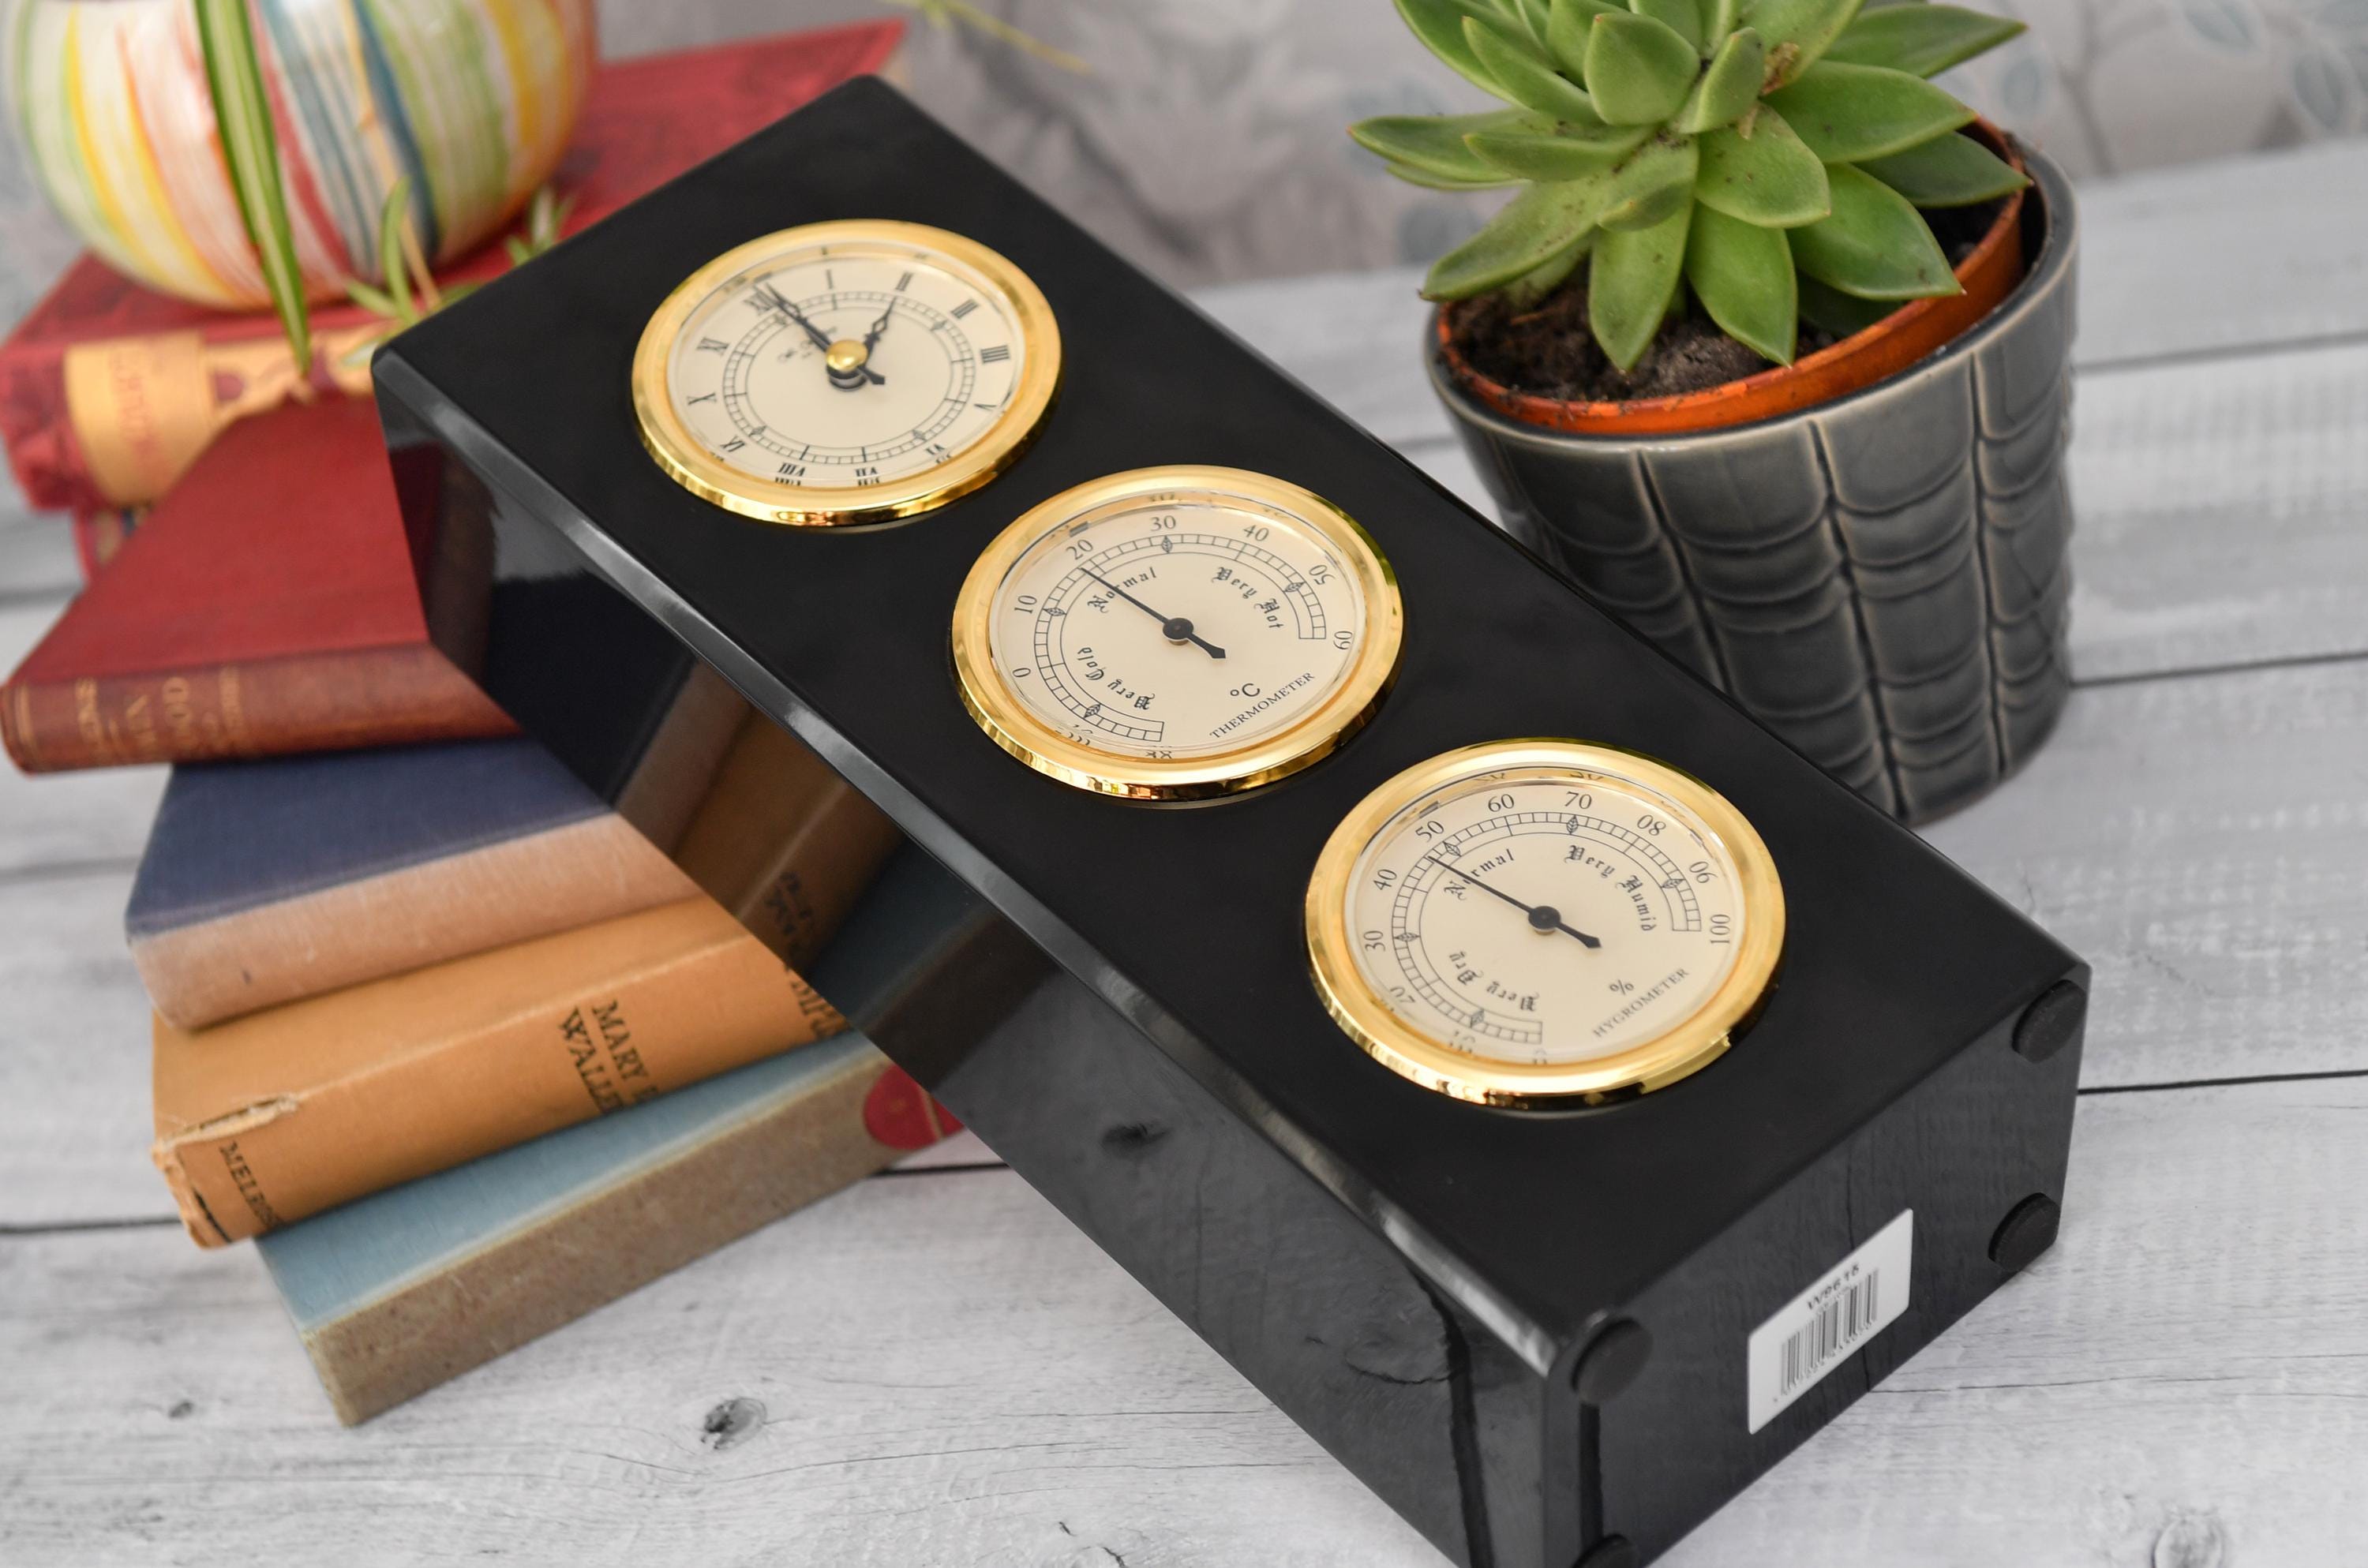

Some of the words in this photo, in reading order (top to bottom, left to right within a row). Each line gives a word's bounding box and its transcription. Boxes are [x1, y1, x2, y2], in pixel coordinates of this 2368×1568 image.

[950, 299, 979, 320] III
[1150, 515, 1177, 532] 30
[1243, 524, 1270, 542] 40
[1066, 539, 1094, 560] 20
[1211, 567, 1257, 600] Very
[1308, 564, 1336, 586] 50
[1087, 567, 1158, 614] Normal
[1014, 595, 1038, 615] 10
[1332, 631, 1353, 650] 60
[1230, 683, 1261, 698] °C
[1209, 672, 1315, 739] THERMOMETER
[1487, 793, 1515, 812] 60
[1564, 791, 1593, 810] 70
[1415, 820, 1444, 843] 50
[1636, 814, 1667, 836] 80
[1564, 844, 1616, 878] Very
[1373, 869, 1398, 891] 40
[1689, 861, 1718, 884] 90
[1709, 914, 1731, 945] 100
[1363, 930, 1386, 952] 30
[1609, 979, 1634, 995] %
[1593, 968, 1690, 1038] HYGROMETER
[592, 999, 650, 1081] MARY
